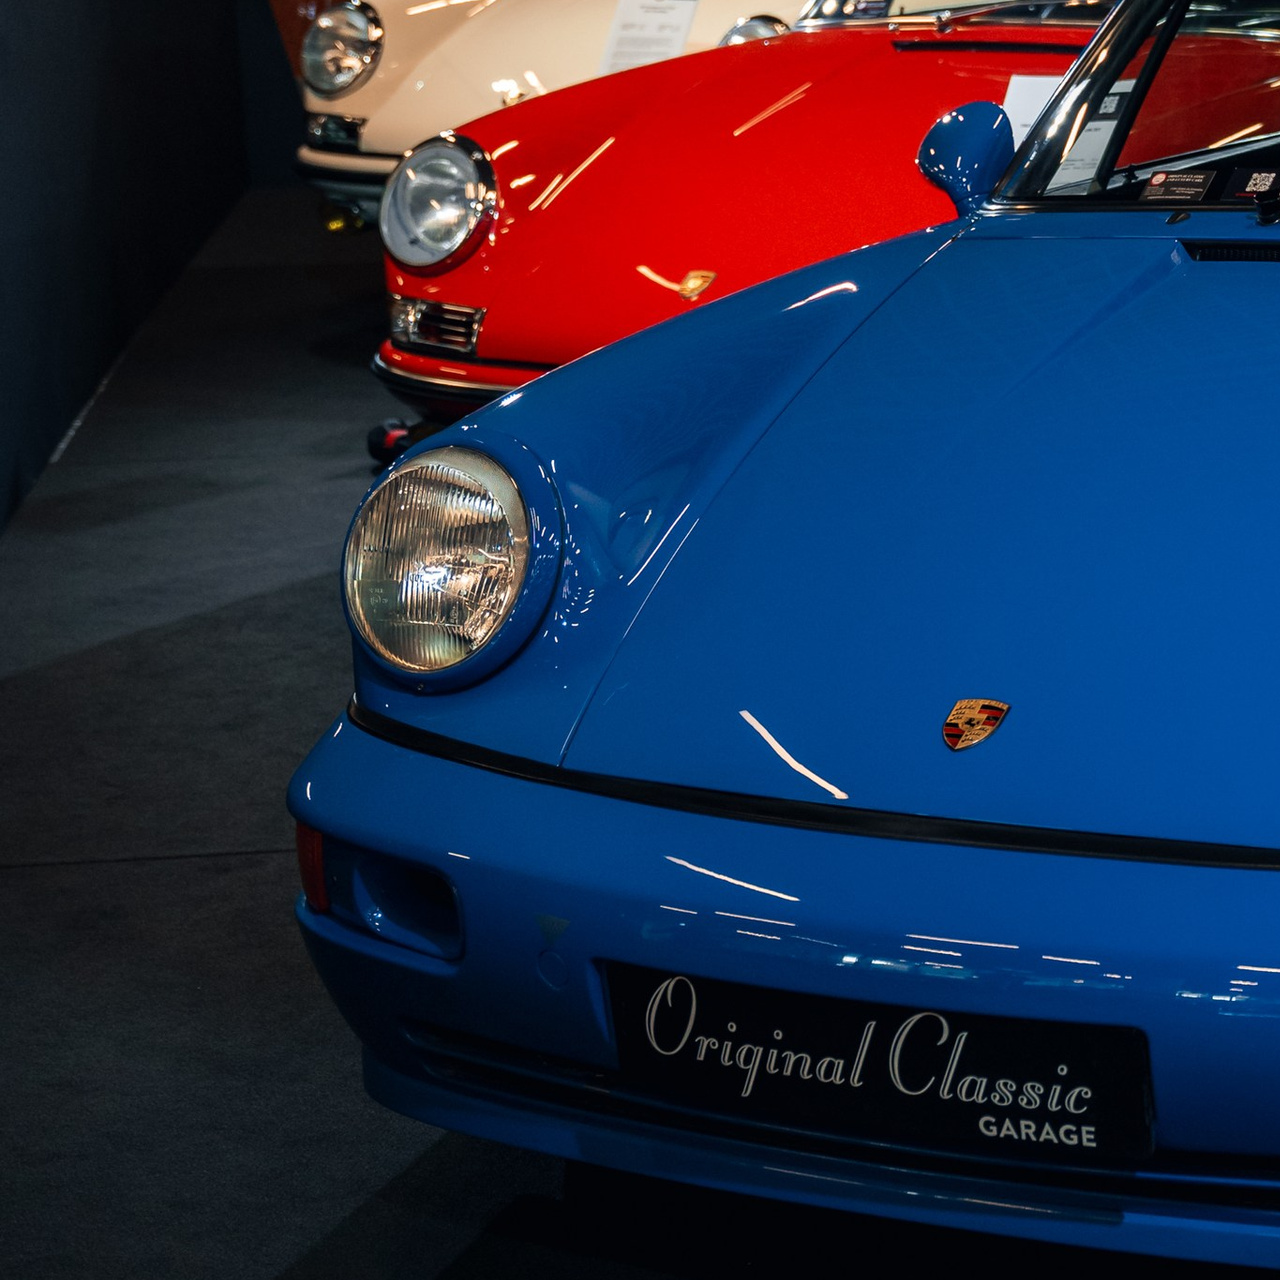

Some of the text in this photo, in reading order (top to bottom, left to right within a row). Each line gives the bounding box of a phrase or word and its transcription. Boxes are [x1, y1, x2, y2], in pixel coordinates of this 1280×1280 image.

[645, 976, 1093, 1114] Original Classic
[978, 1116, 1097, 1148] GARAGE
